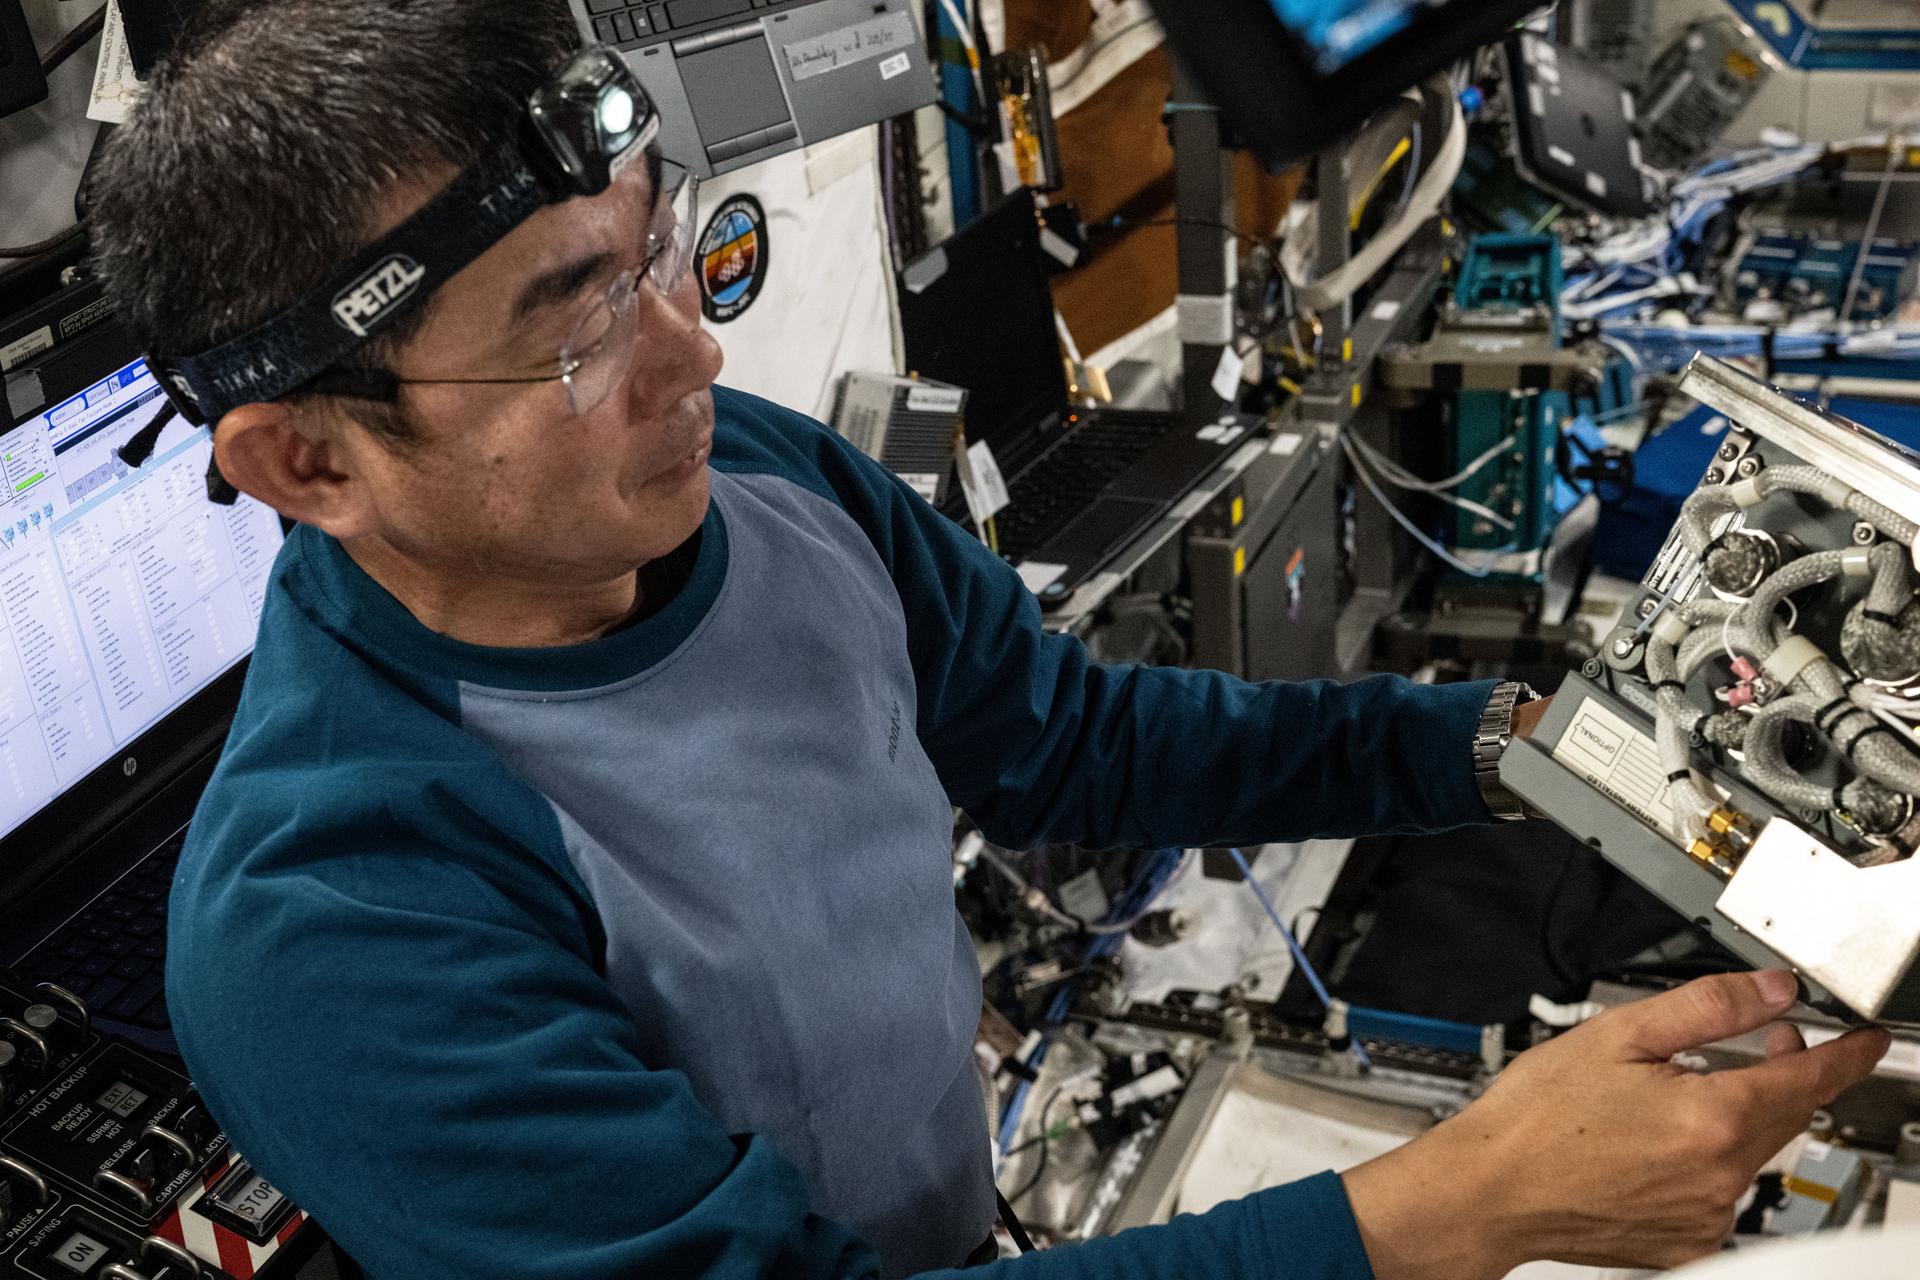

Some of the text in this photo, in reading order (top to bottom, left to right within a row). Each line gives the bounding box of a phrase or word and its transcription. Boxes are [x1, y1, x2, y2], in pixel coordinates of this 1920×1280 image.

[107, 22, 116, 37] AND
[101, 38, 113, 70] CONTROL
[480, 167, 537, 214] TIK
[333, 260, 426, 336] PETZL
[213, 358, 278, 393] TIKKA
[1580, 726, 1616, 755] OPTIONAL
[123, 757, 137, 776] hp
[1587, 773, 1660, 828] BATTERY INSTALLED
[57, 1057, 71, 1069] OFF
[15, 1094, 30, 1106] OFF
[28, 1066, 89, 1118] HOT BACKUP
[105, 1087, 125, 1105] EXT
[120, 1096, 139, 1112] RET
[51, 1103, 85, 1132] BACKUP
[66, 1106, 94, 1132] READY
[148, 1097, 180, 1126] BACKUP
[87, 1118, 117, 1144] SSRMS
[105, 1122, 125, 1140] HOT
[205, 1131, 229, 1155] ACTIV
[99, 1138, 137, 1170] RELEASE
[155, 1167, 193, 1203] CAPTURE
[238, 1181, 275, 1216] STOP
[6, 1213, 36, 1239] PAUSE
[29, 1217, 62, 1247] SAFING
[68, 1242, 95, 1263] ON
